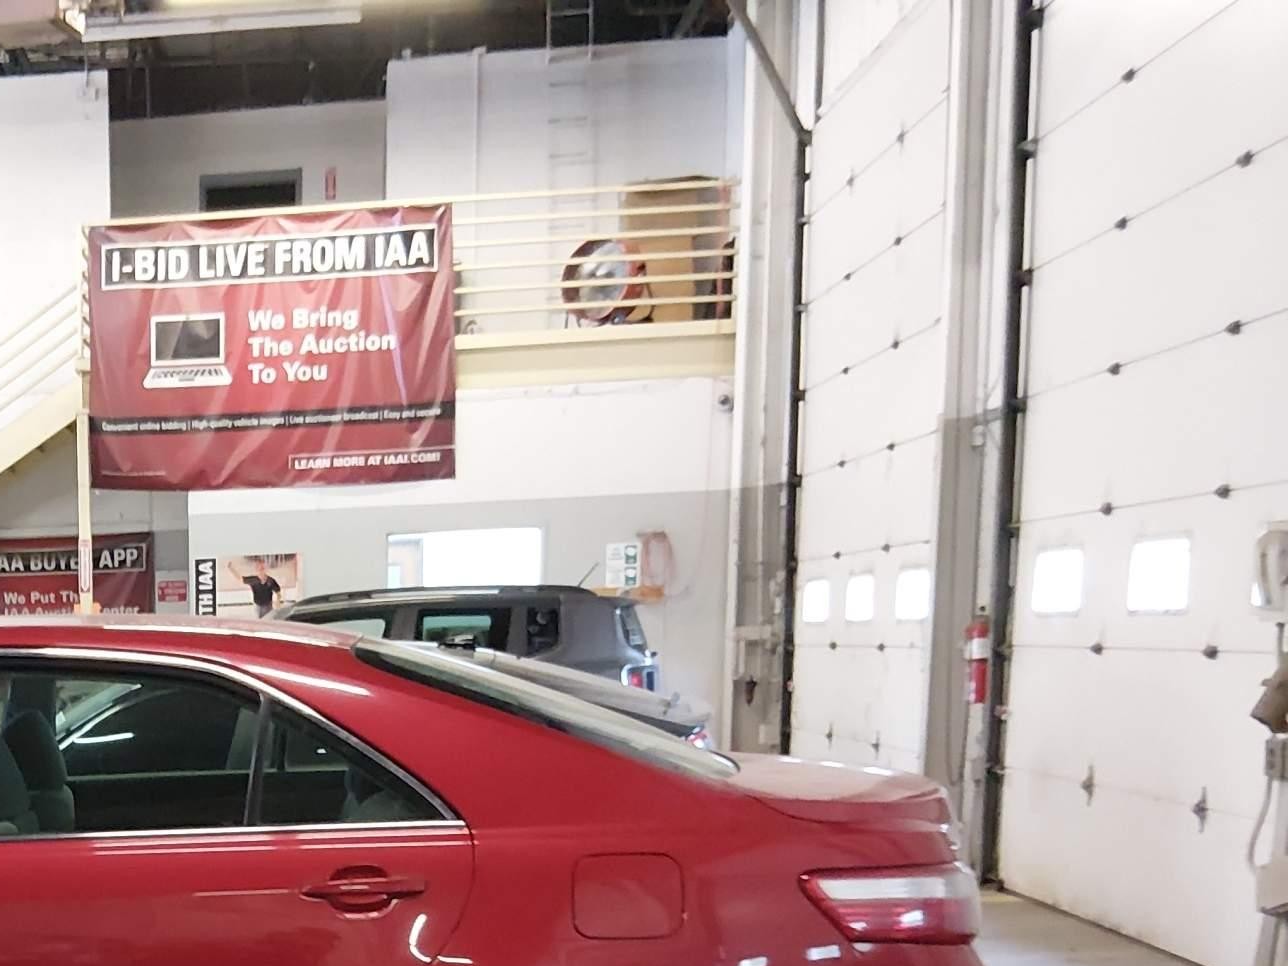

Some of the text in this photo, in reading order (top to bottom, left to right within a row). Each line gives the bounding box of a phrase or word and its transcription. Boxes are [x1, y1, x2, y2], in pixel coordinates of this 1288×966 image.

[112, 231, 430, 282] I-BID LIVE FROM IAA
[248, 306, 358, 331] We Bring
[248, 331, 397, 357] The Auction
[248, 361, 328, 384] To You
[294, 457, 331, 470] LEARN
[333, 455, 365, 468] MORE
[367, 454, 382, 466] AT
[30, 550, 81, 571] BUYE
[99, 547, 138, 569] APP
[198, 561, 214, 590] IAA
[4, 590, 79, 605] We Put Th
